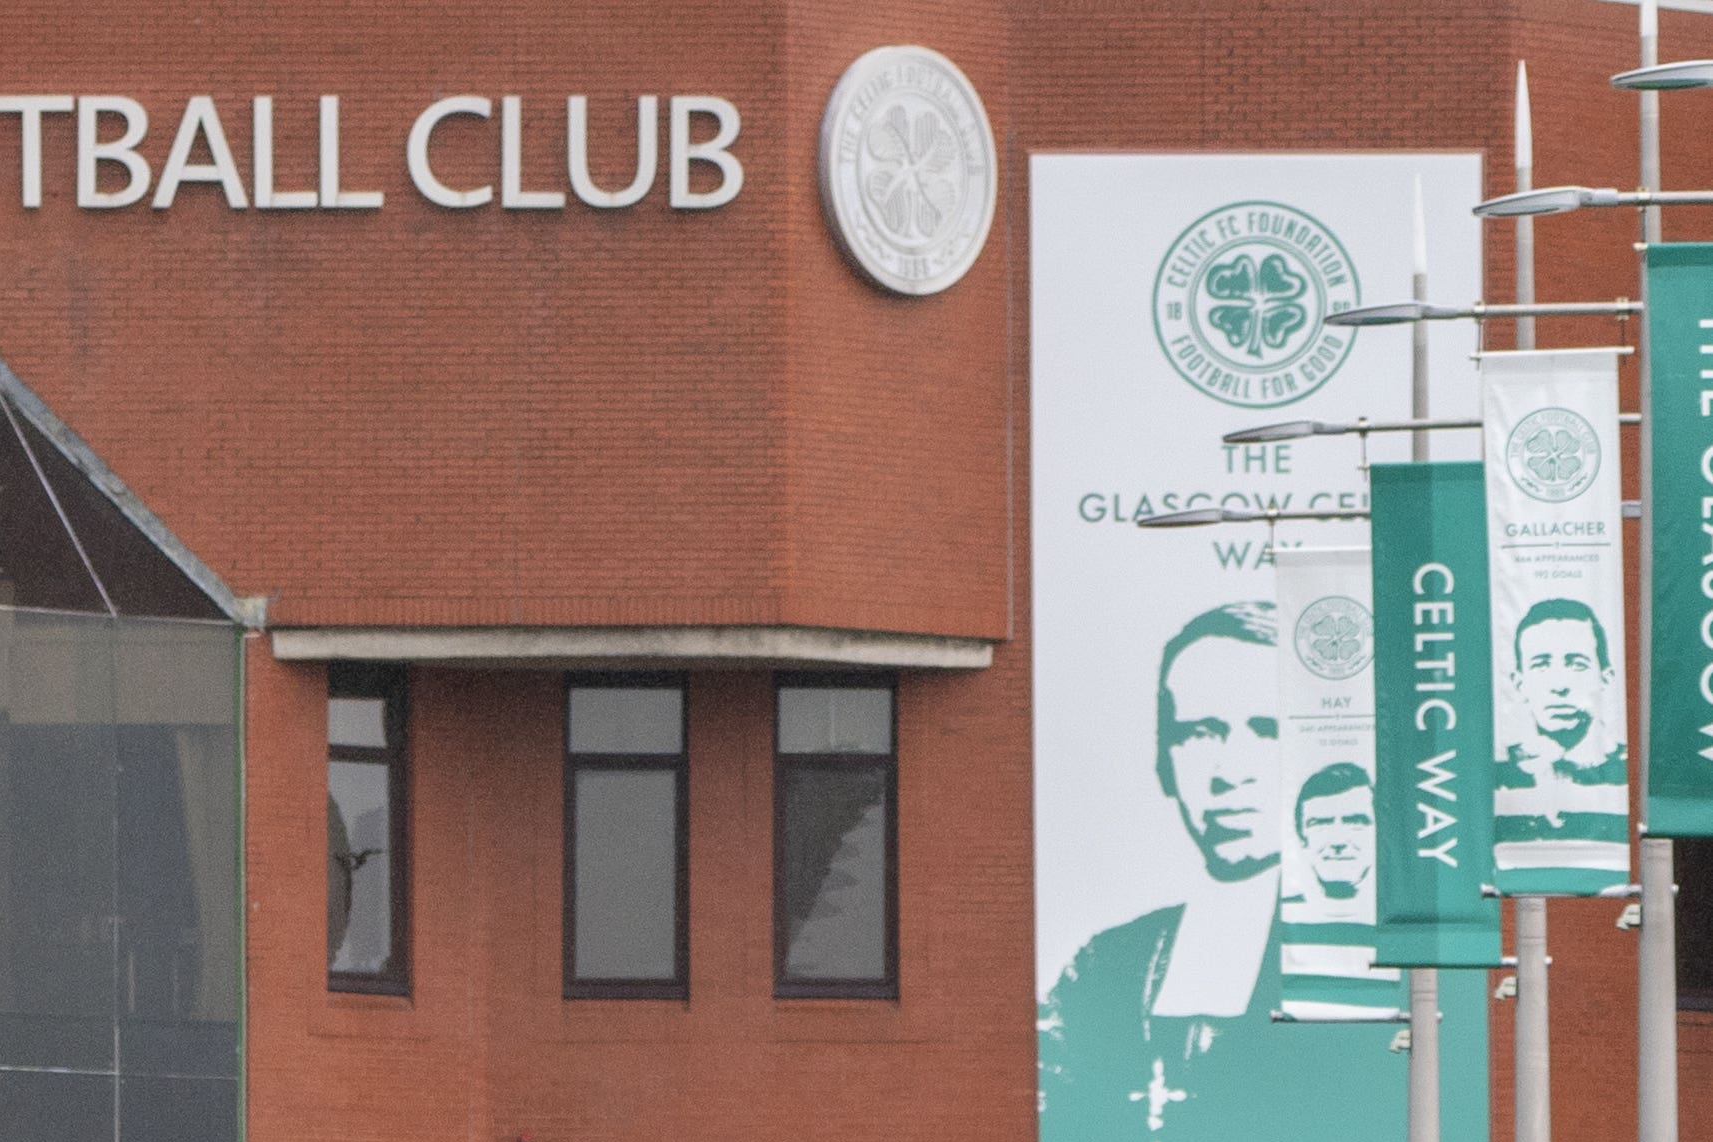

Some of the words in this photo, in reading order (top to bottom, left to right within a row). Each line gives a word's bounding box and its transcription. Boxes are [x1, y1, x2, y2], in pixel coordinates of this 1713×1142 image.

[406, 94, 744, 208] CLUB
[1166, 228, 1216, 289] CELTIC
[1215, 214, 1241, 239] FC
[1246, 210, 1347, 289] FOUNDATION
[1170, 333, 1252, 400] FOOTBALL
[1261, 371, 1299, 400] FOR
[1299, 333, 1344, 383] GOOD
[1221, 444, 1292, 474] THE
[1212, 541, 1303, 571] WA
[1504, 521, 1607, 538] GALLACHER
[1412, 562, 1457, 732] CELTIC
[1320, 696, 1353, 710] HAY
[1416, 748, 1459, 868] WAY
